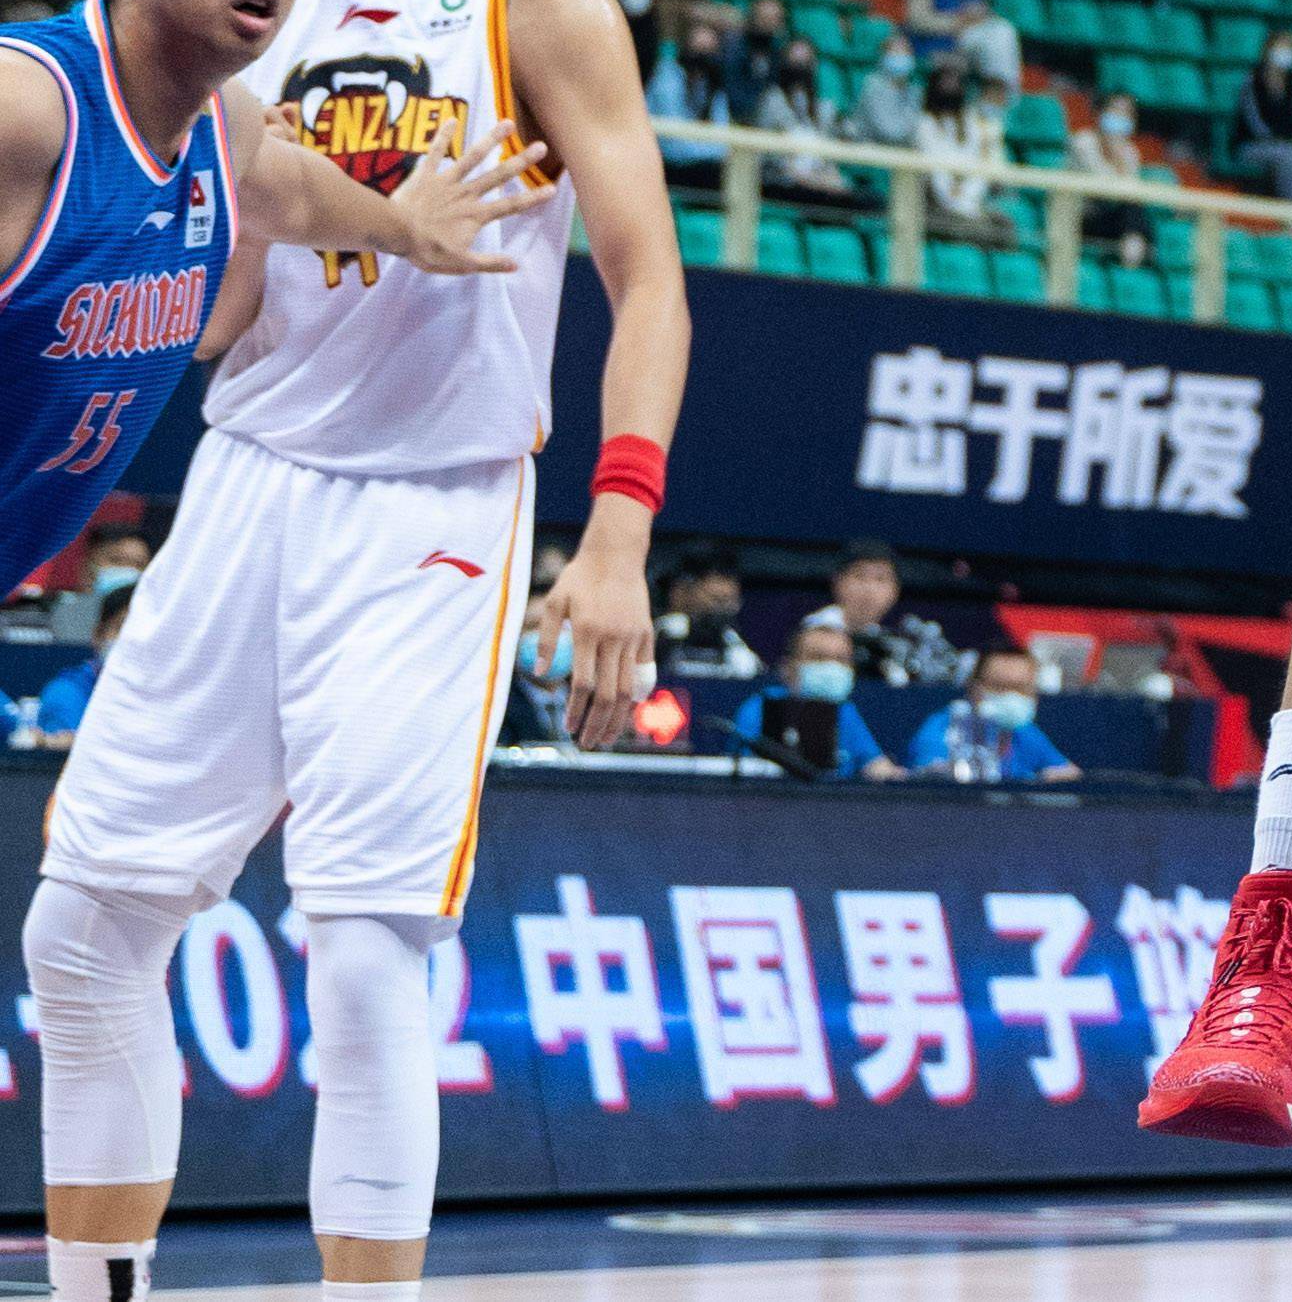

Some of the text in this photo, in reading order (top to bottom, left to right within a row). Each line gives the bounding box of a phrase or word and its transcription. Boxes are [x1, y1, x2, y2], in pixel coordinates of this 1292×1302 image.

[294, 94, 468, 161] ENZHEN
[42, 264, 207, 359] SICHUAN
[36, 388, 138, 474] 55
[854, 344, 1265, 519] 忠于所爱
